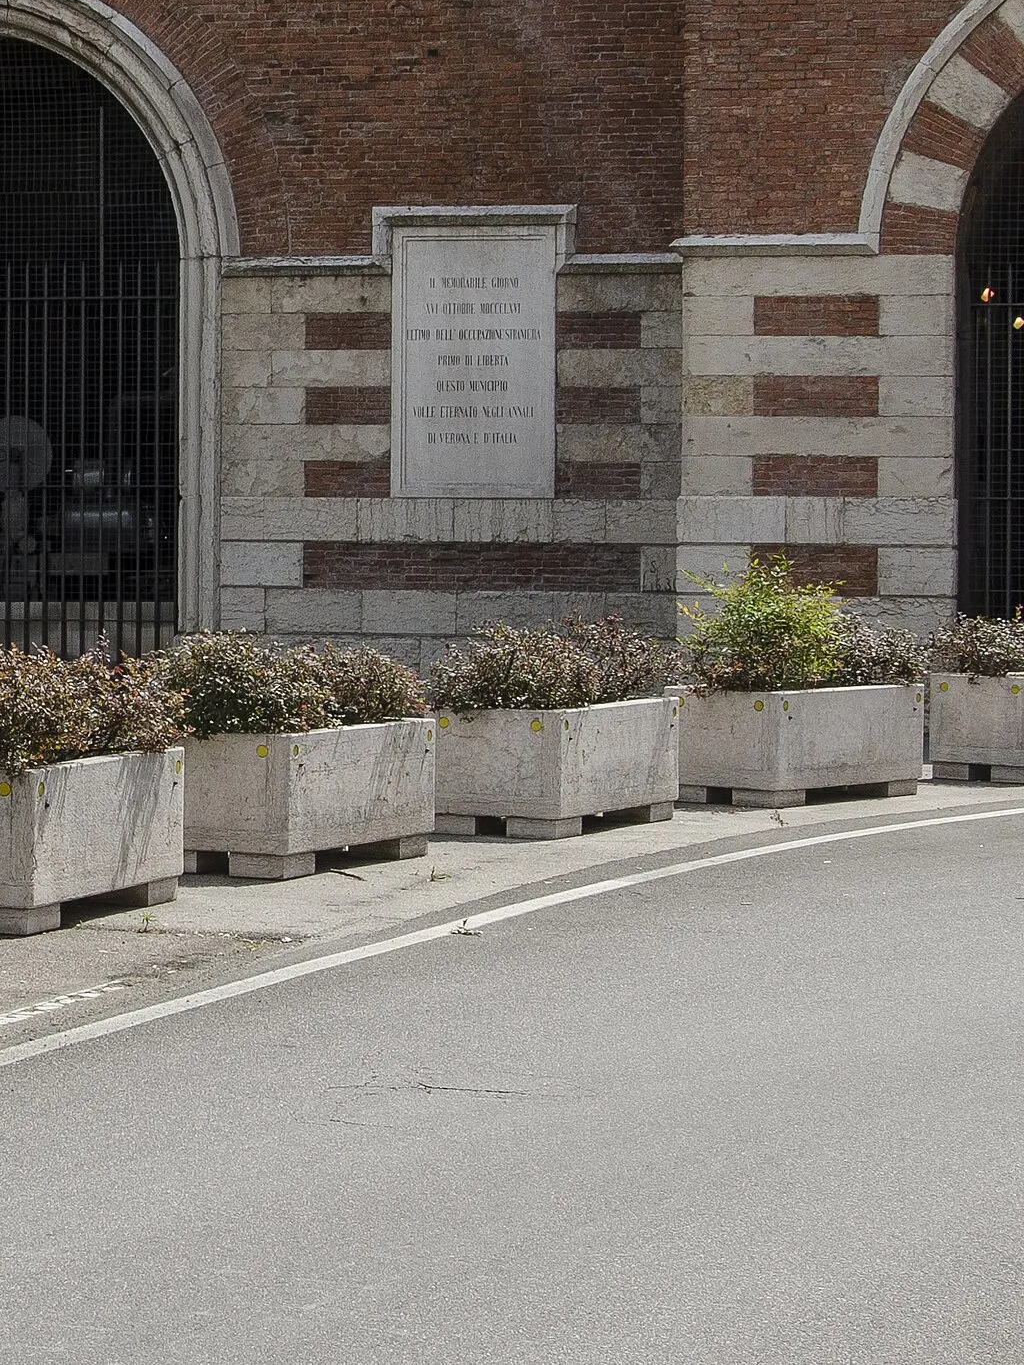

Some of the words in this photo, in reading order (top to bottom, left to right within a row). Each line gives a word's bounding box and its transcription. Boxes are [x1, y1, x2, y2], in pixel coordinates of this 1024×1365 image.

[429, 277, 435, 289] IL
[441, 277, 487, 289] MEMORABILE
[491, 277, 519, 289] GIORNO
[426, 303, 438, 315] XVI
[442, 303, 475, 315] OTTOBRE
[480, 303, 521, 315] MDCCCLXVI
[407, 329, 431, 341] ULTIMO
[505, 329, 541, 341] STRANIERA
[437, 355, 460, 367] PRIMO
[464, 355, 473, 367] DI
[436, 380, 465, 393] QUESTO
[469, 380, 508, 393] MUNICIPIO
[412, 406, 435, 418] VOLLE
[440, 406, 478, 418] ETERNATO
[482, 406, 504, 418] NEGLI
[508, 406, 534, 418] ANNALI
[427, 432, 436, 444] DI
[439, 432, 471, 444] VERONA
[483, 432, 518, 444] D'ITALIA
